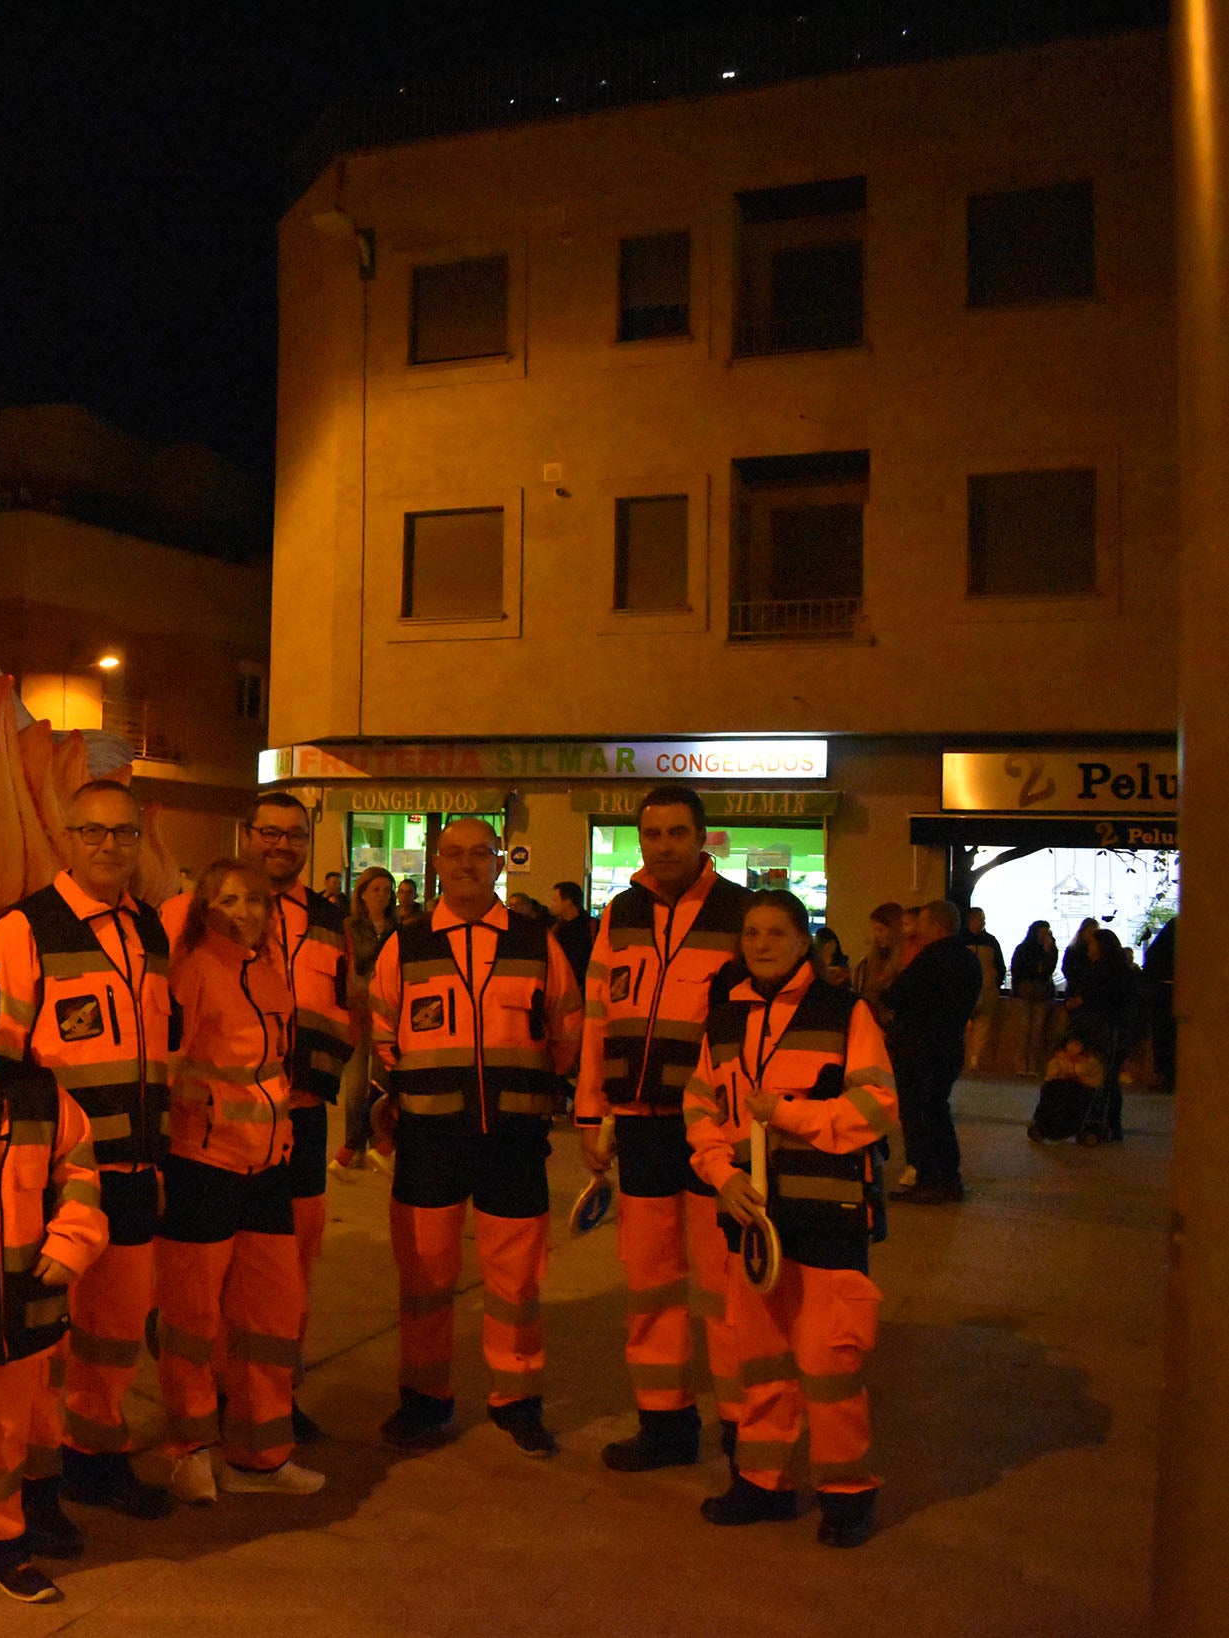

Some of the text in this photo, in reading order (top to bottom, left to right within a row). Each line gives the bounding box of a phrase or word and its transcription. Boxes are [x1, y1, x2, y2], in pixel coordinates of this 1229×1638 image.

[496, 747, 636, 773] SILMAR
[656, 753, 814, 773] CONGELADOS
[352, 791, 478, 811] CONGELADOS
[725, 792, 805, 814] SILMAR
